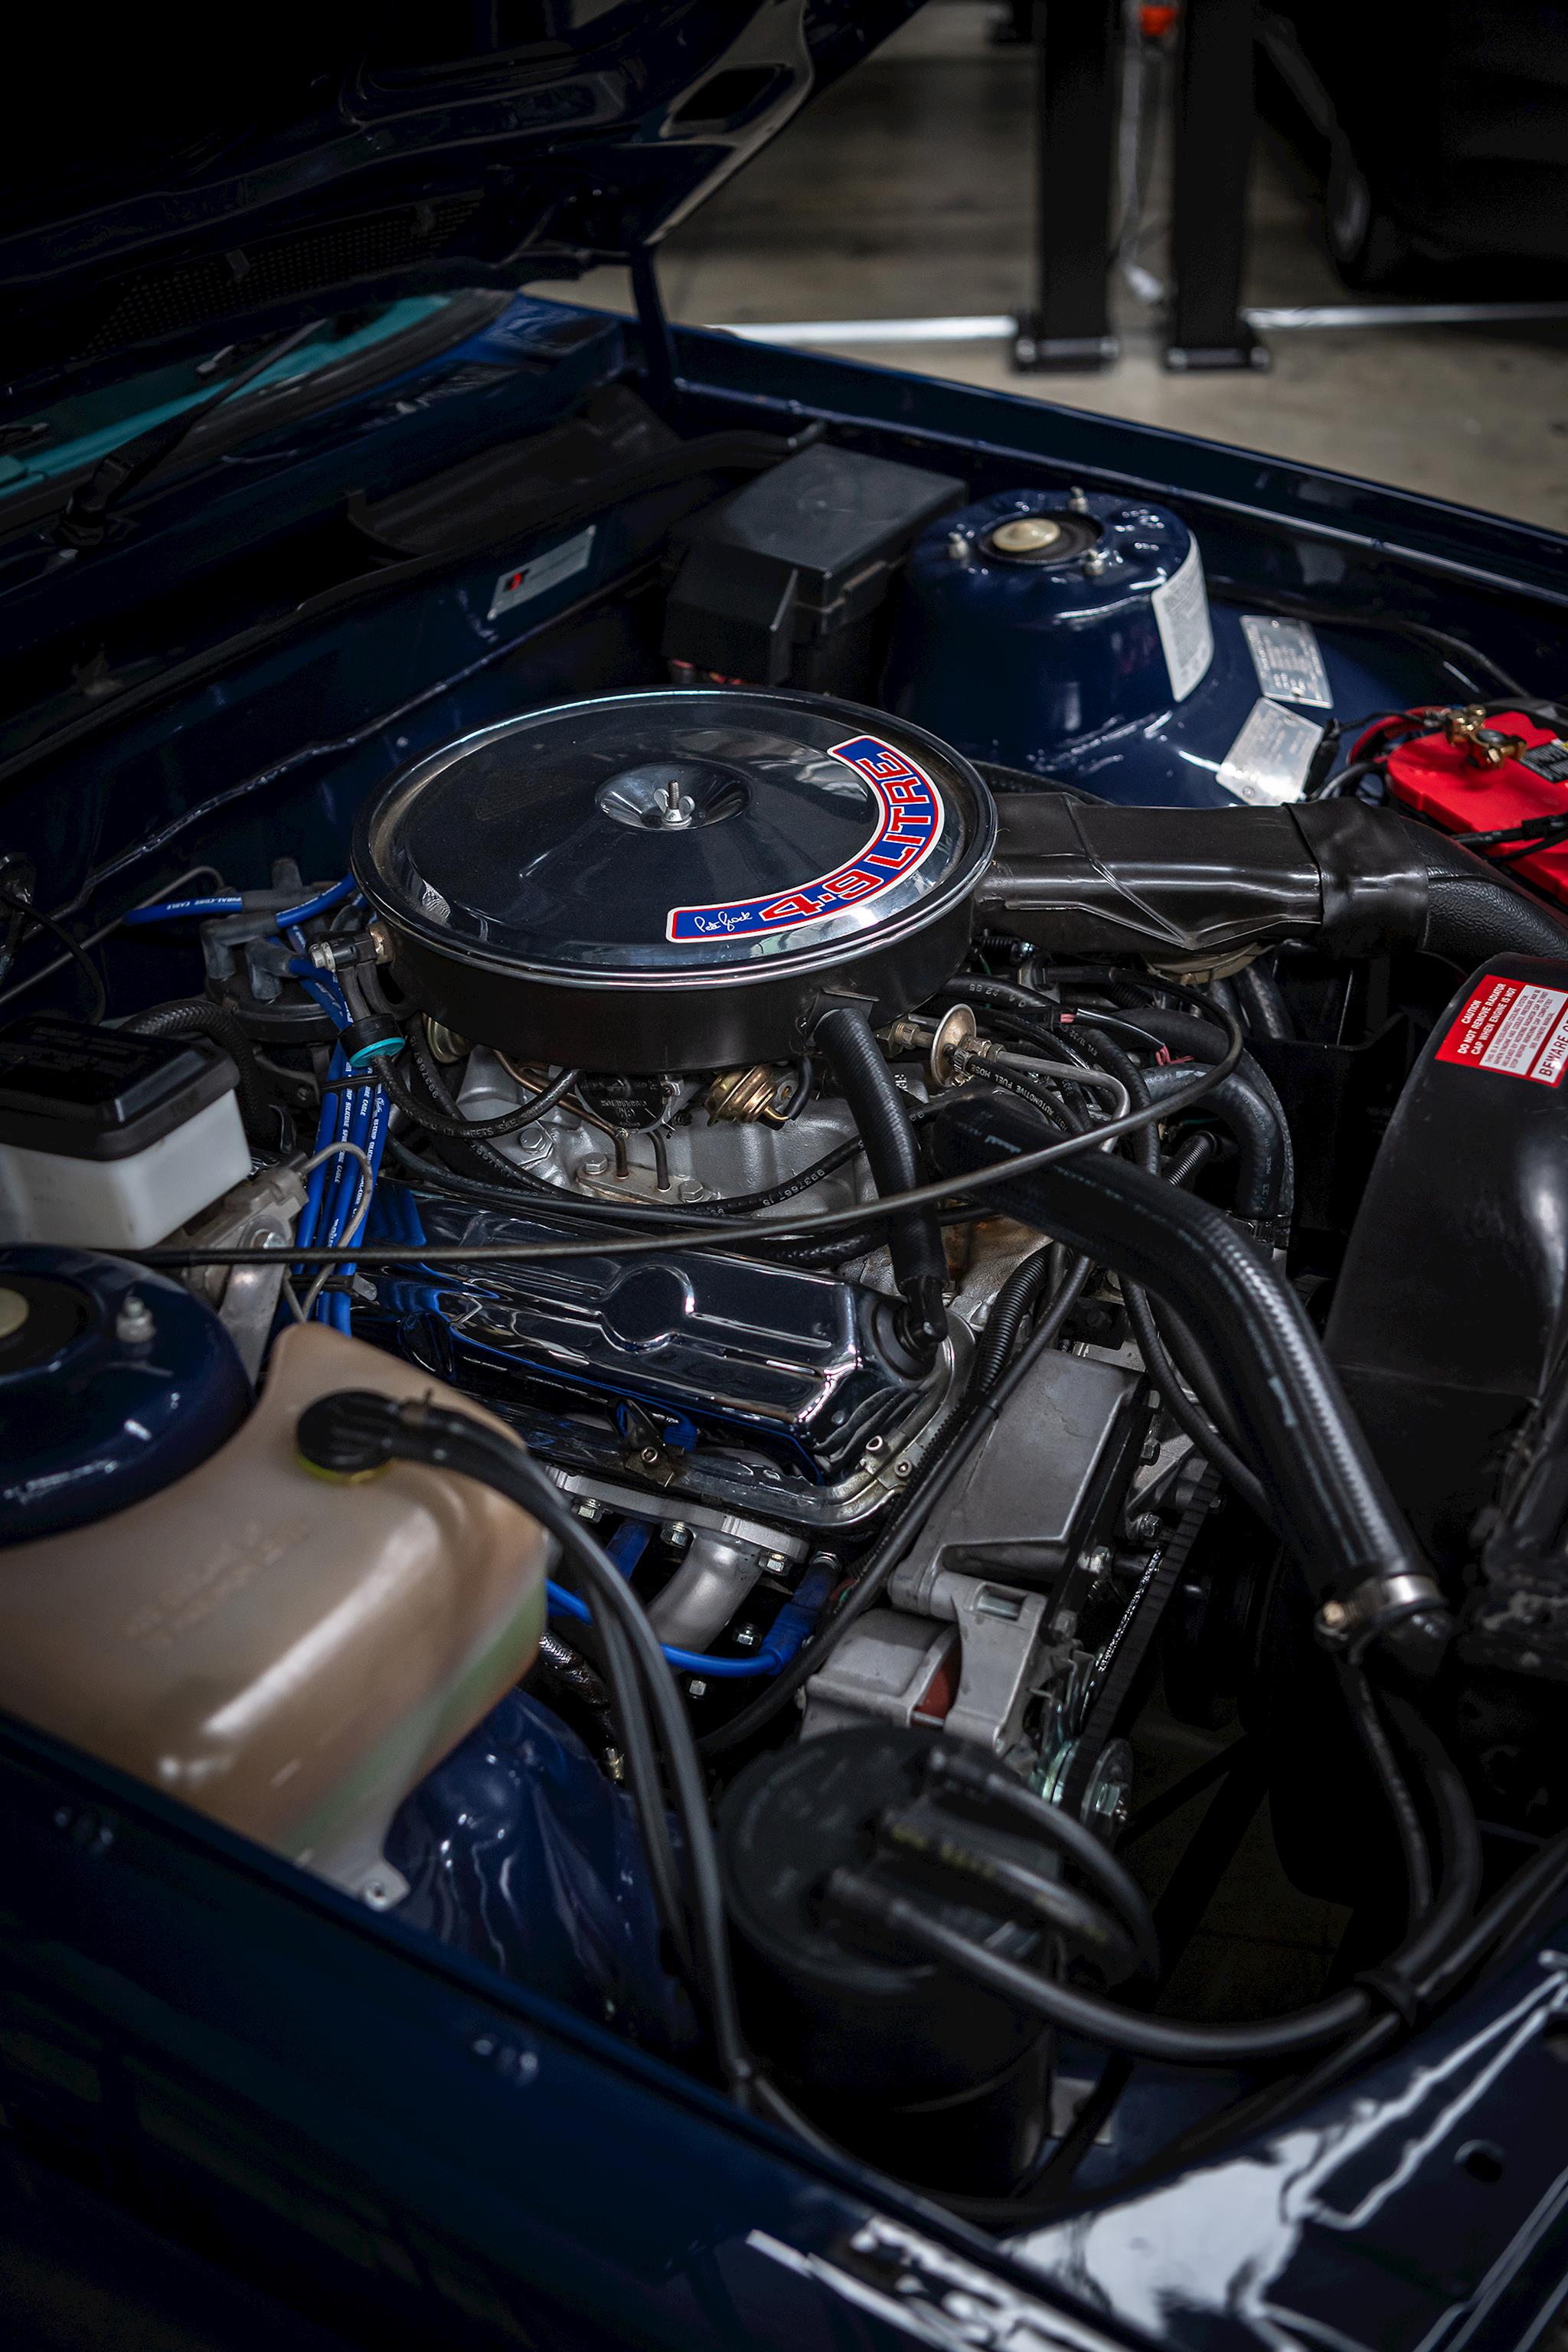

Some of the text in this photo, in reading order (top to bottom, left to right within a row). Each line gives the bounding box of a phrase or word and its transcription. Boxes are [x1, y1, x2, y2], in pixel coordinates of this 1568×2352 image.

[857, 751, 932, 871] LITRE
[194, 897, 243, 906] PIRAL-CORE
[1456, 982, 1507, 1054] DO NOT REMOVE RADIATOR
[1459, 999, 1482, 1024] CAUTION
[1469, 1040, 1485, 1055] CAP
[1477, 1022, 1495, 1040] WHEN
[1488, 1002, 1508, 1023] ENGINE
[1504, 987, 1517, 997] HOT
[1538, 1034, 1568, 1076] BEWARE
[971, 1063, 991, 1079] HOSE
[995, 1073, 1014, 1089] FUEL
[360, 1099, 368, 1116] CABLE
[1015, 1084, 1054, 1116] AUTOMOTIVE
[343, 1102, 351, 1128] SILICONE
[371, 1119, 379, 1140] HI-TEMP
[335, 1165, 343, 1184] CABLE
